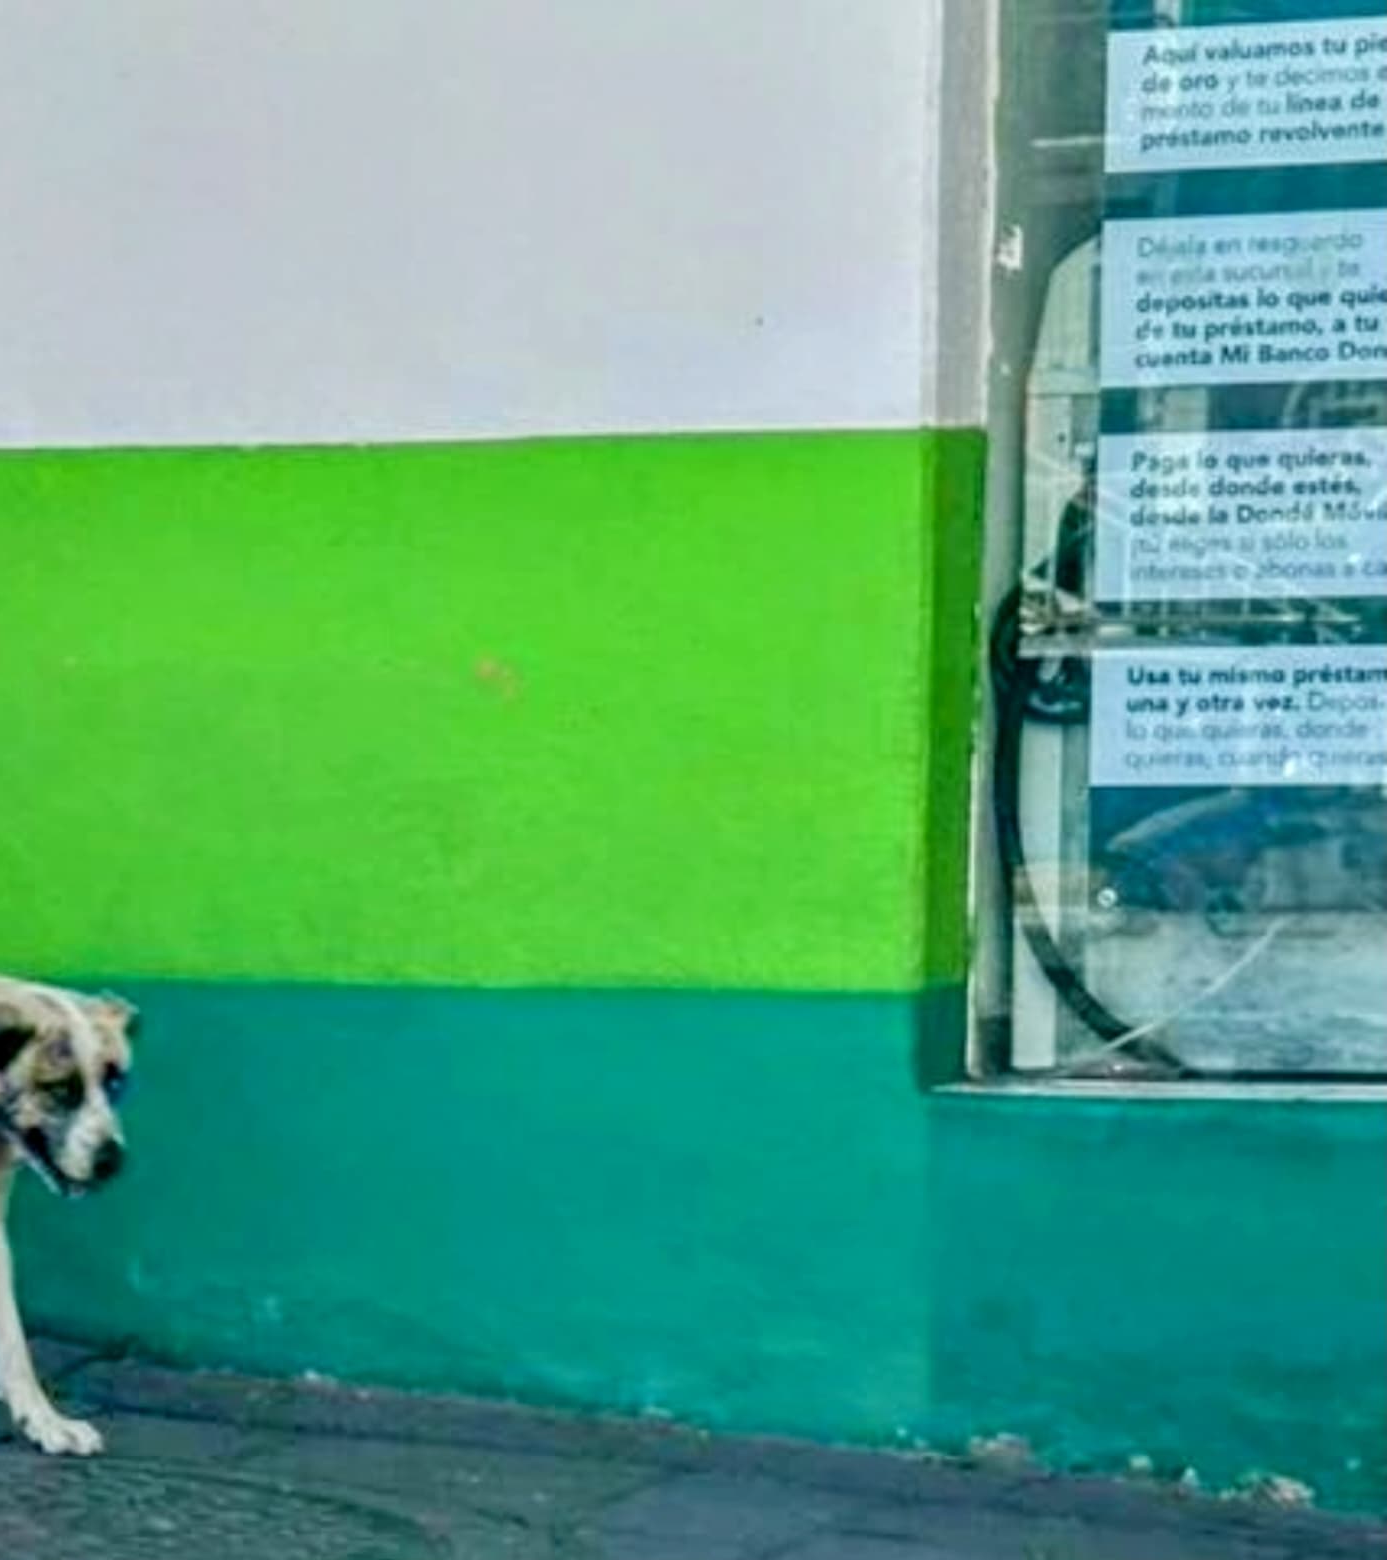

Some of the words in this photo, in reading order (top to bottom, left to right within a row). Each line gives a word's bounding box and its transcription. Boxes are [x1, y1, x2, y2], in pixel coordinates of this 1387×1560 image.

[1143, 45, 1196, 66] Aquí
[1205, 38, 1314, 60] valuamos
[1324, 38, 1346, 54] tu
[1141, 73, 1171, 93] de
[1180, 74, 1219, 91] oro
[1247, 70, 1268, 87] te
[1275, 65, 1369, 87] decimos
[1222, 98, 1244, 117] de
[1285, 92, 1342, 113] línea
[1351, 88, 1379, 109] de
[1141, 127, 1251, 151] préstamo
[1260, 120, 1384, 143] revolvente
[1136, 291, 1249, 317] depositas
[1258, 288, 1280, 308] lo
[1287, 291, 1331, 312] que
[1172, 321, 1197, 339] tu
[1205, 315, 1323, 342] préstamo,
[1332, 318, 1346, 333] a
[1354, 315, 1378, 333] tu
[1135, 349, 1213, 369] cuenta
[1221, 345, 1249, 364] Mi
[1259, 344, 1330, 363] Banco
[1132, 451, 1189, 476] Paga
[1198, 450, 1218, 469] lo
[1225, 453, 1270, 473] que
[1279, 447, 1371, 472] quieras,
[1131, 478, 1200, 499] desde
[1209, 475, 1285, 496] donde
[1293, 473, 1362, 496] estés,
[1130, 506, 1200, 527] desde
[1209, 506, 1229, 525] la
[1127, 667, 1171, 685] Usa
[1179, 667, 1202, 685] tu
[1209, 665, 1284, 684] mismo
[1127, 697, 1168, 712] una
[1177, 697, 1190, 717] y
[1197, 693, 1244, 711] otra
[1254, 696, 1300, 711] vez.
